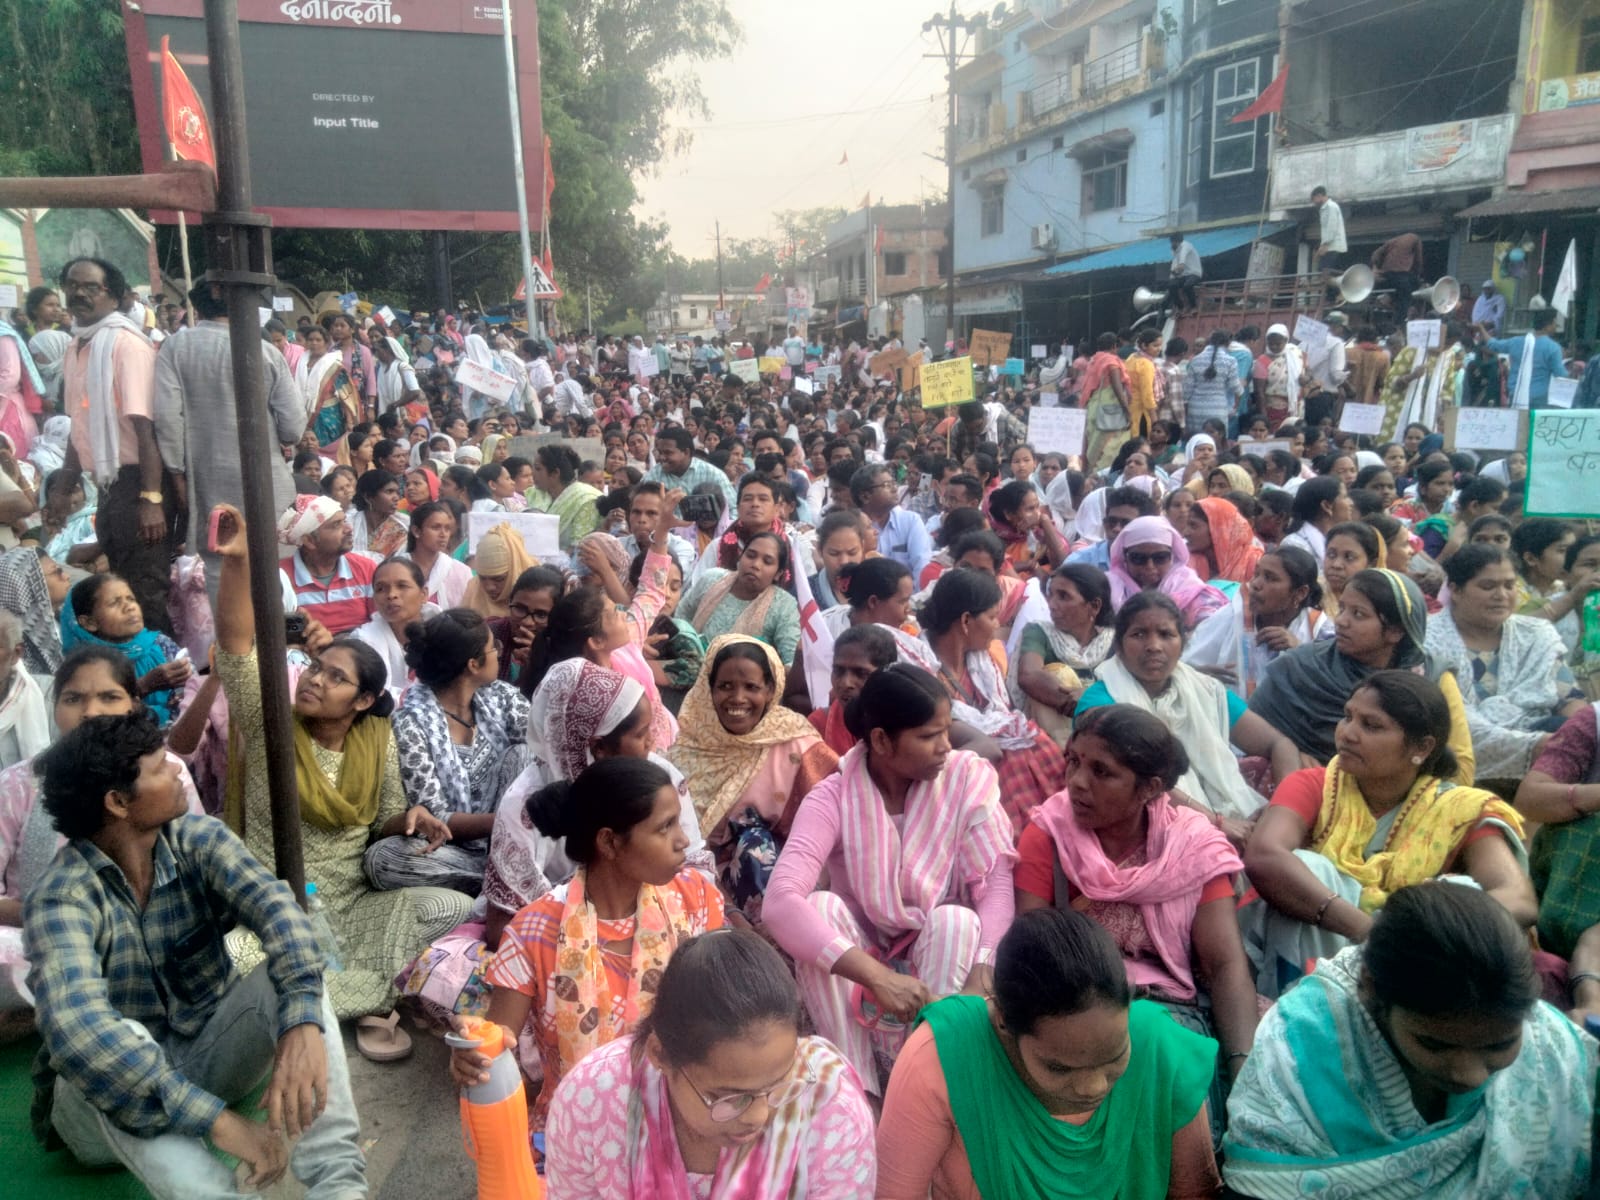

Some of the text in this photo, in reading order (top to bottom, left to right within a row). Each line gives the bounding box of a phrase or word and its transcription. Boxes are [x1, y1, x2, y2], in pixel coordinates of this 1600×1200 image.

[312, 92, 375, 103] DIRECTED BY
[313, 116, 379, 129] Input Title
